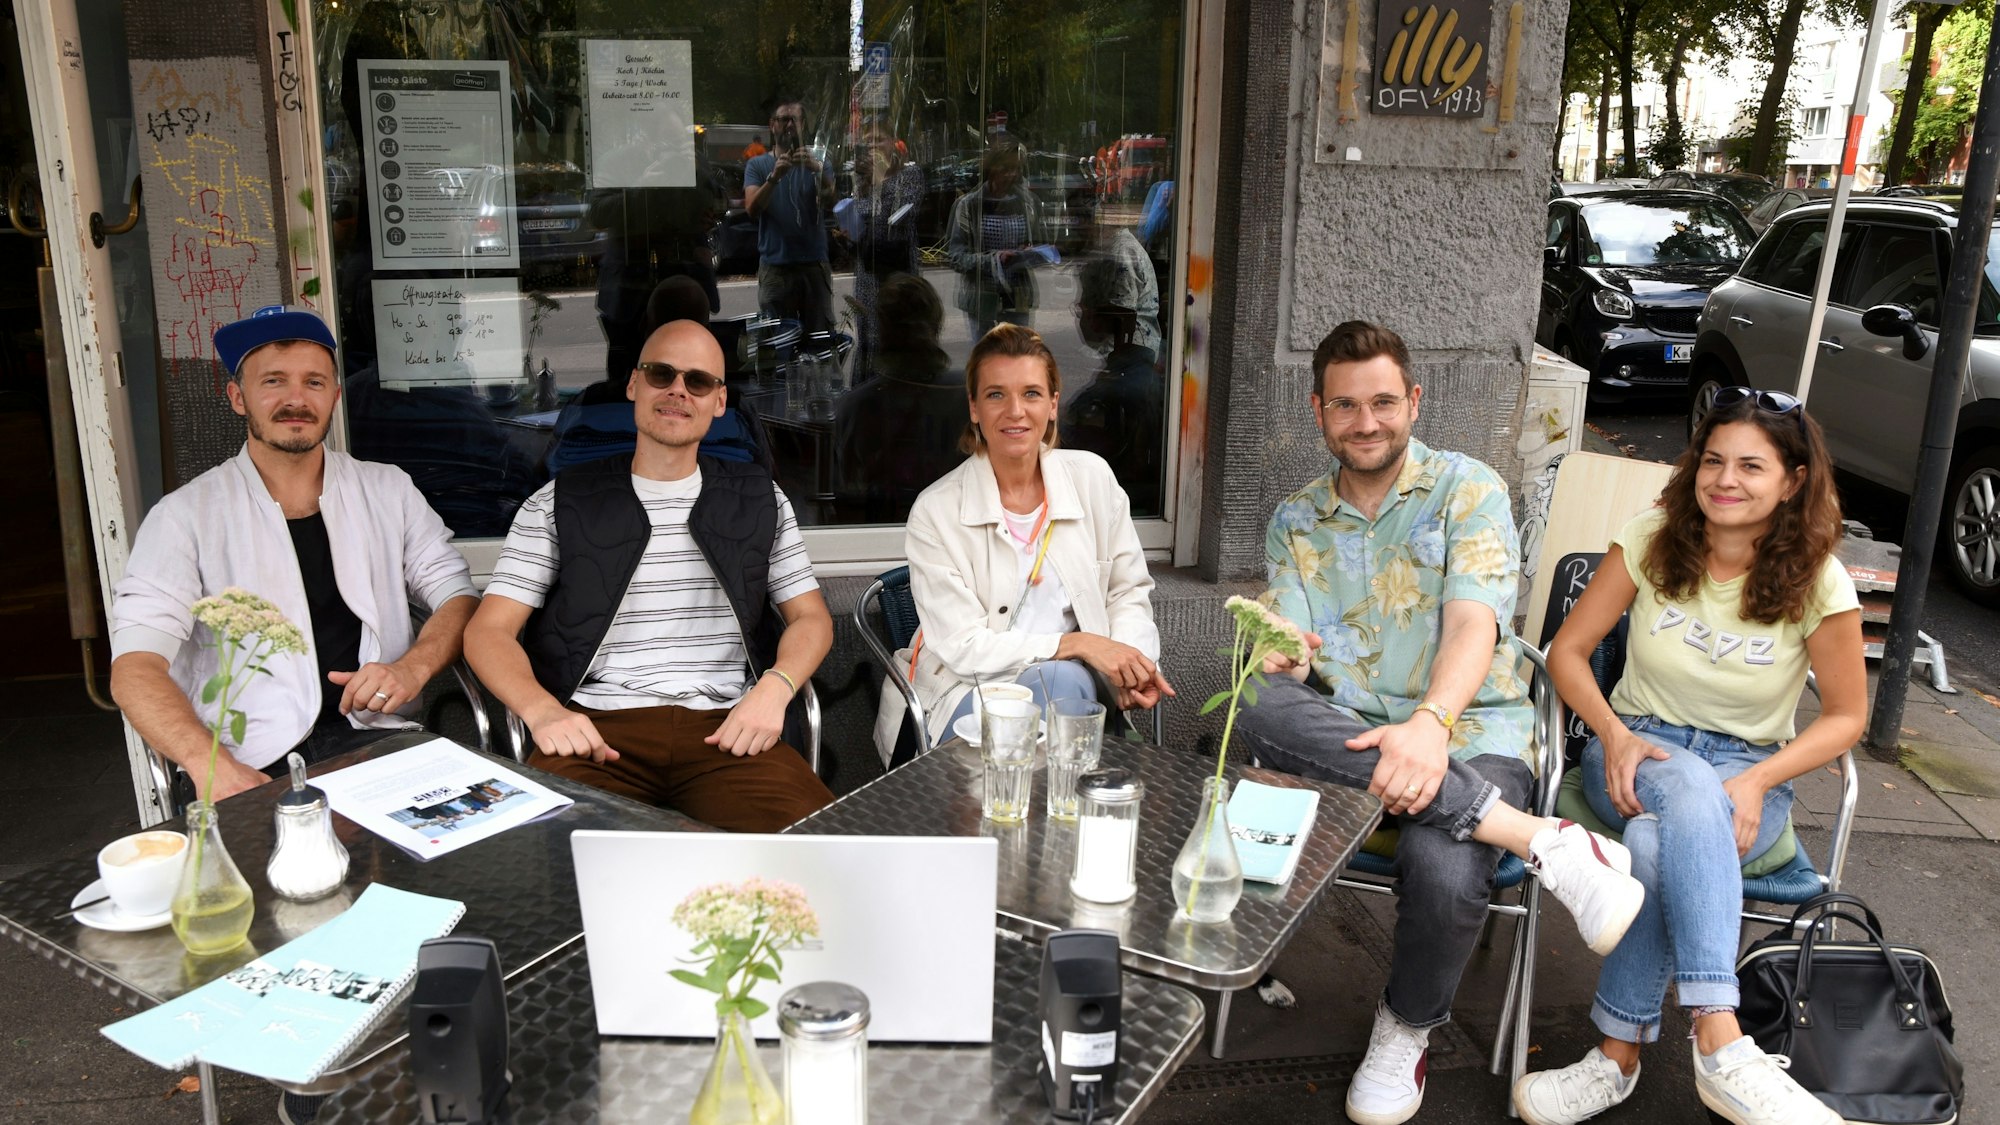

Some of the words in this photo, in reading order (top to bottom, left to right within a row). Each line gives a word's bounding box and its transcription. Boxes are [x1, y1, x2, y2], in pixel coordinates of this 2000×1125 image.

[1383, 4, 1483, 107] illy
[374, 75, 399, 84] Liebe
[401, 75, 428, 85] Gäste
[455, 77, 484, 87] geöffnet
[620, 80, 639, 89] Tage
[602, 91, 638, 99] Arbeitszeit
[390, 311, 403, 328] Mo
[415, 313, 429, 329] Sa
[403, 331, 414, 344] So
[405, 350, 430, 366] Küche
[436, 349, 446, 364] bis
[1849, 570, 1877, 580] step
[1649, 603, 1775, 666] pepe
